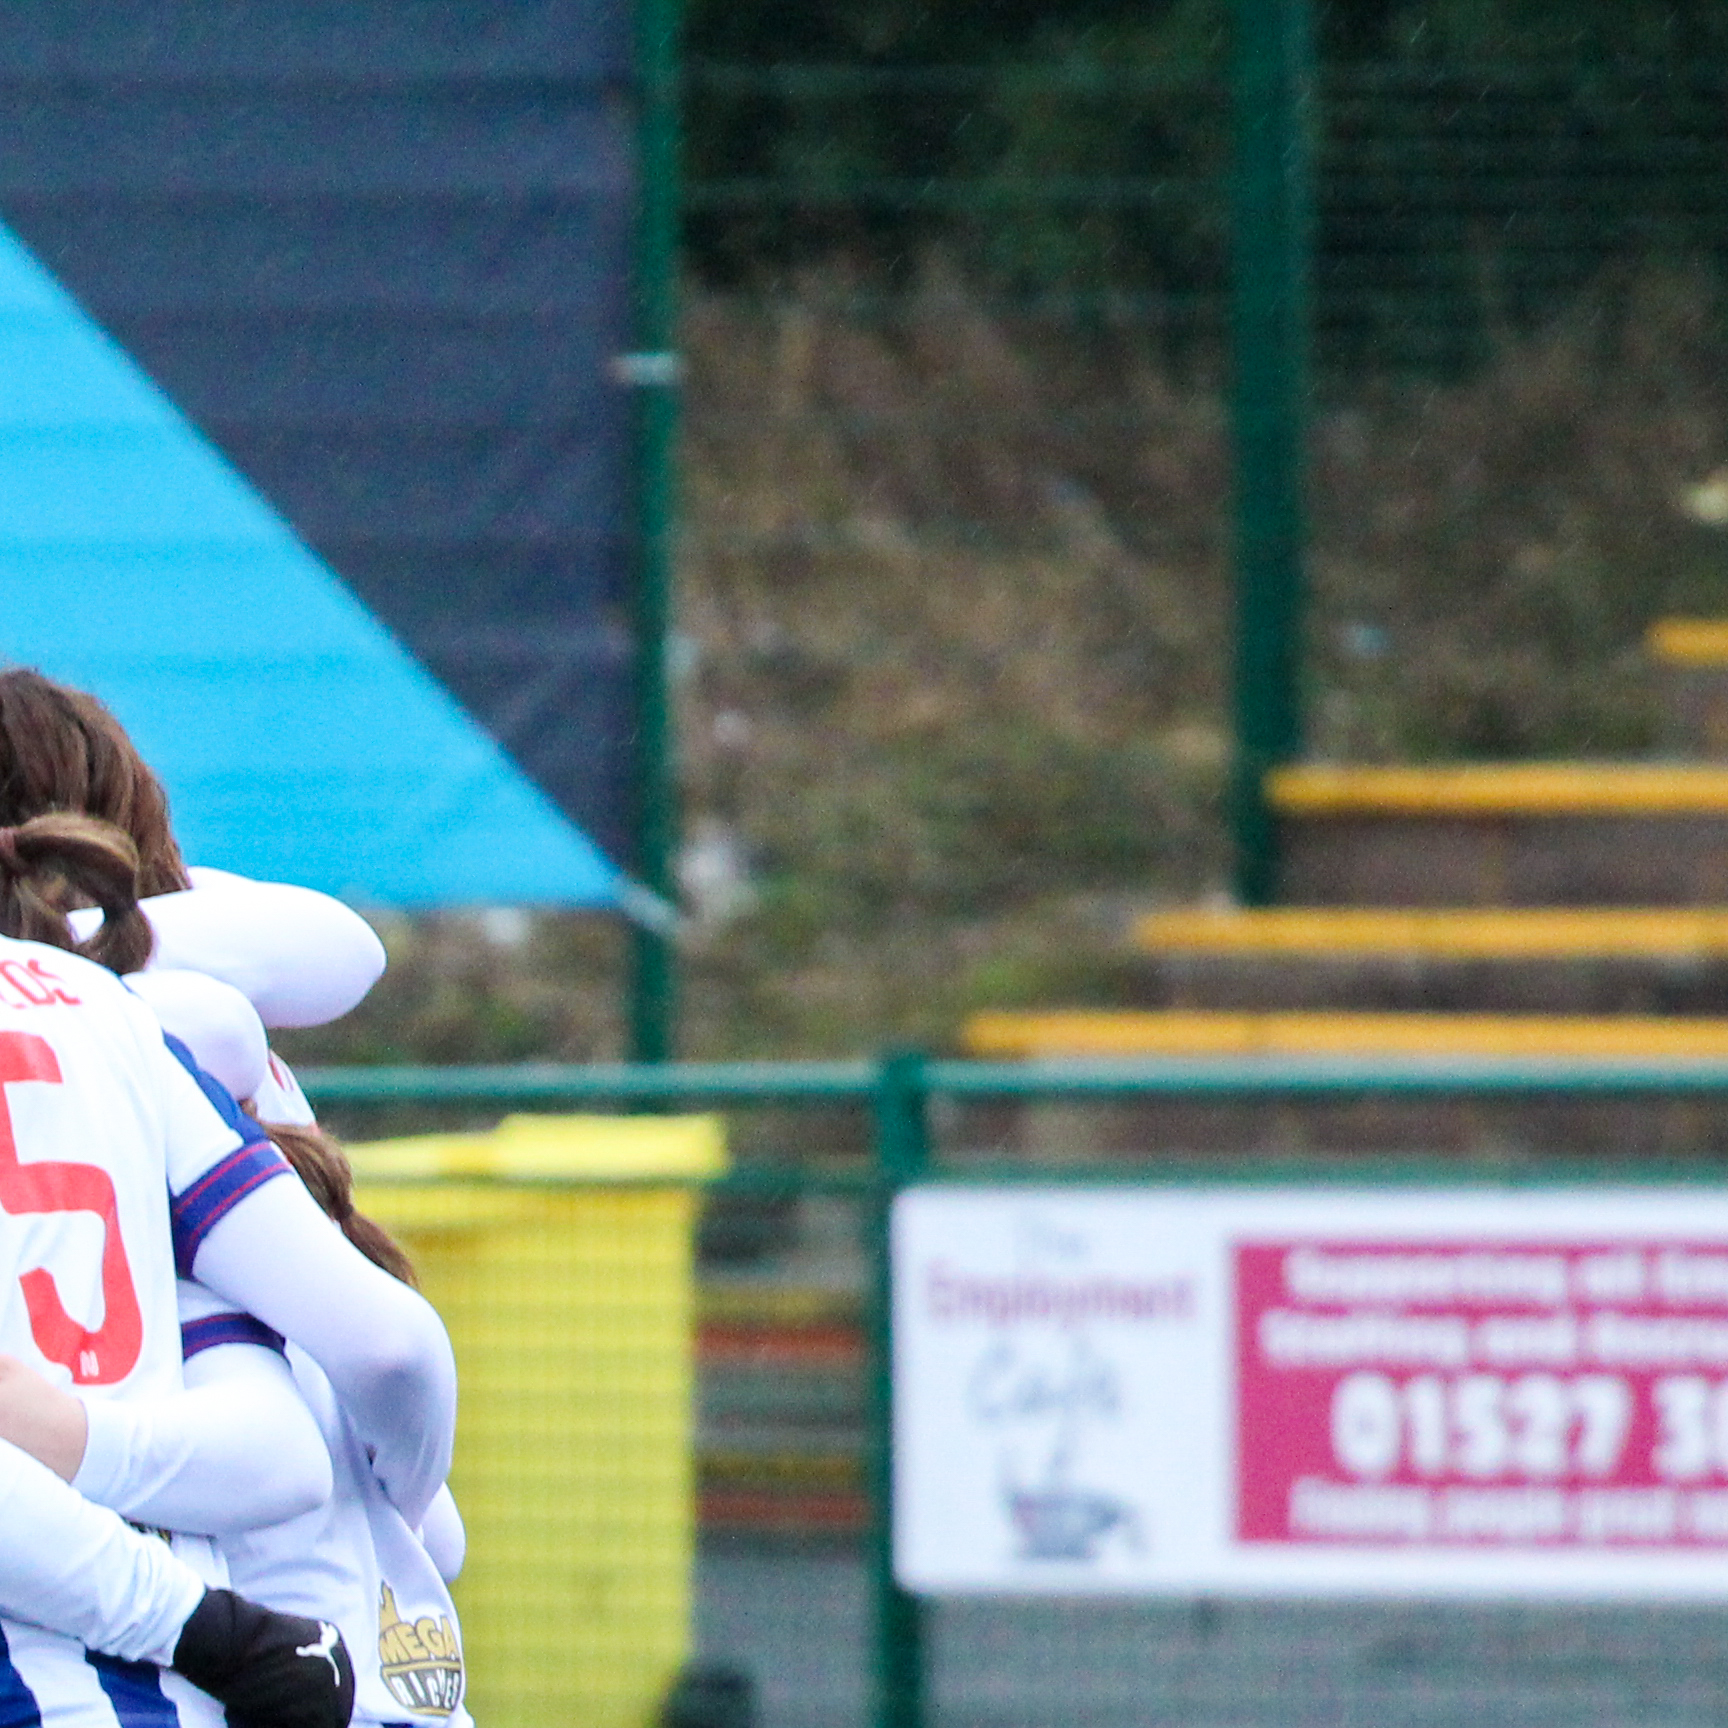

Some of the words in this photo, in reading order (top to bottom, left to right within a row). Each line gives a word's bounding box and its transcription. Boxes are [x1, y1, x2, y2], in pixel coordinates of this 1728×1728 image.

[1331, 1368, 1631, 1478] 01527
[1651, 1368, 1728, 1478] 3
[379, 1615, 459, 1666] MEGA
